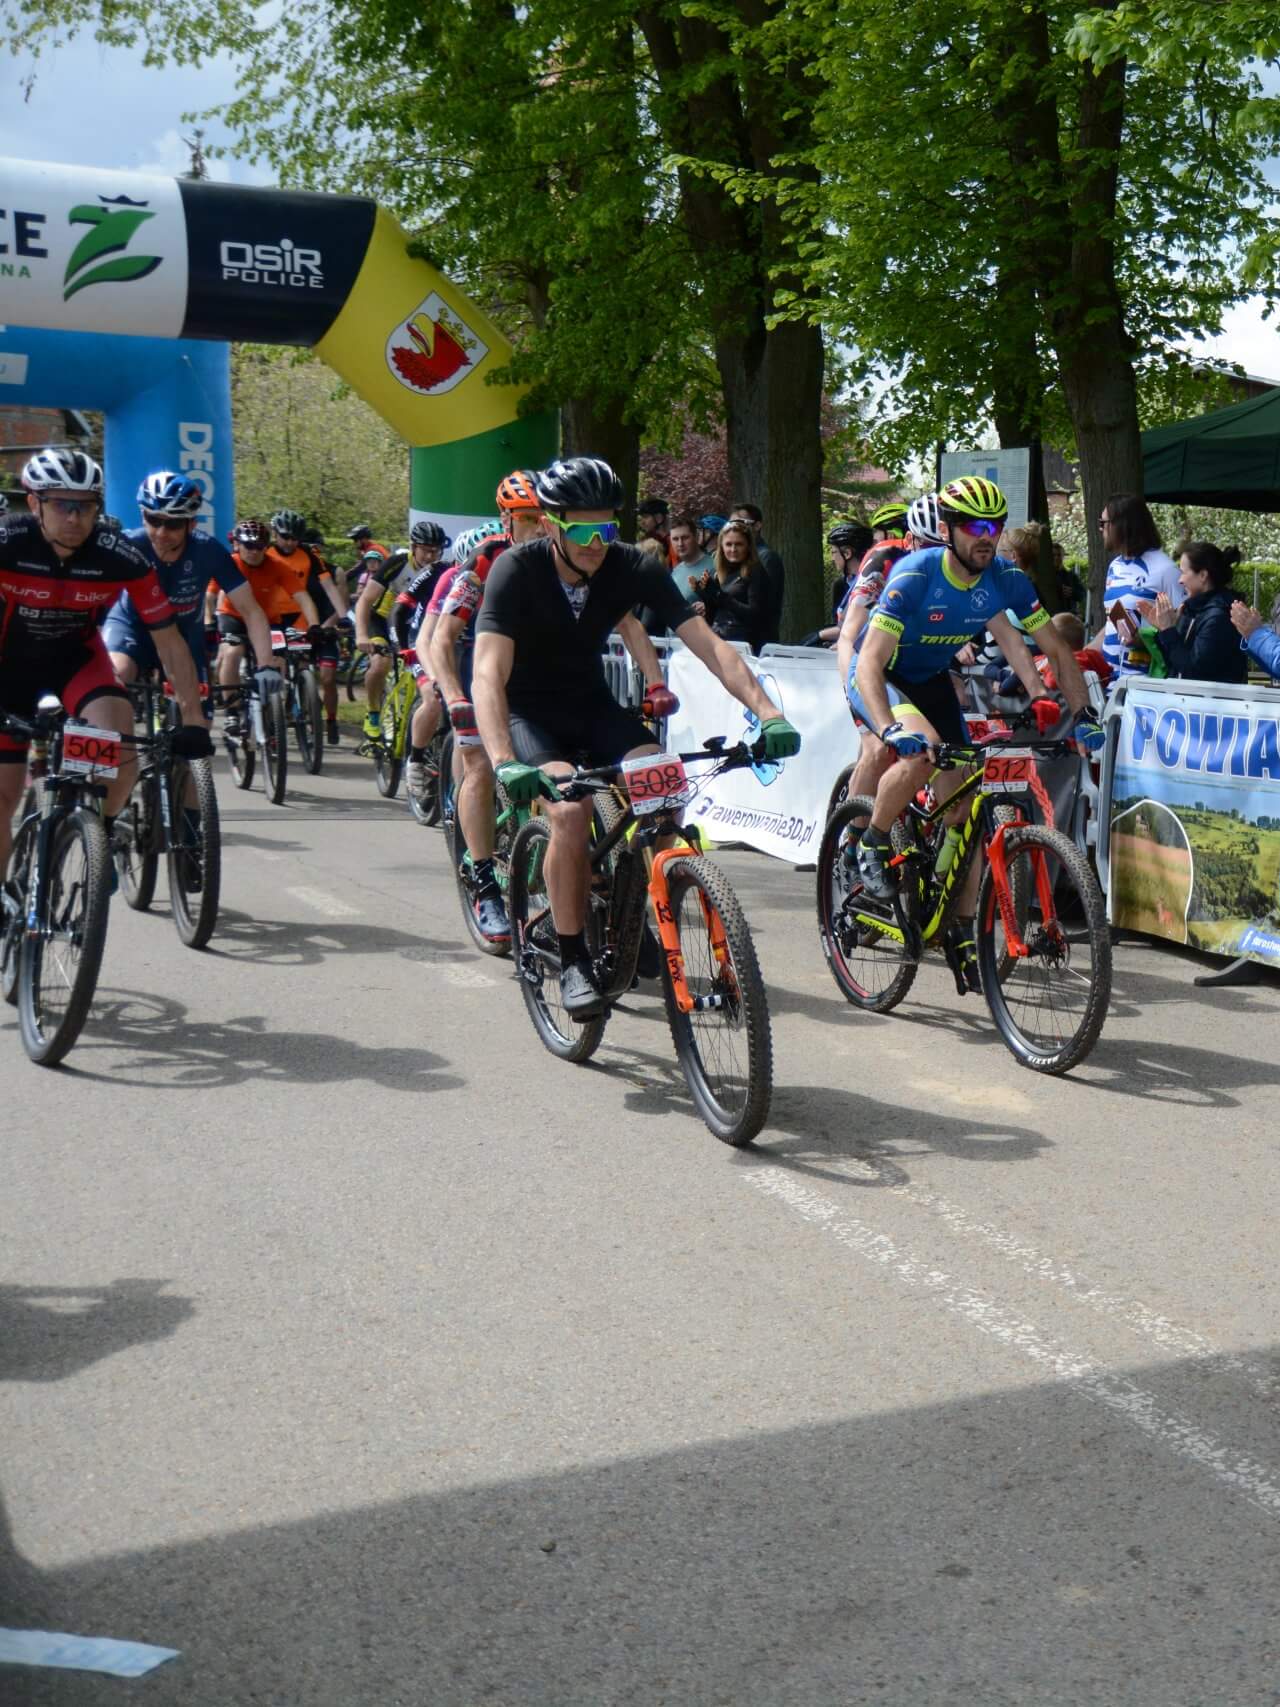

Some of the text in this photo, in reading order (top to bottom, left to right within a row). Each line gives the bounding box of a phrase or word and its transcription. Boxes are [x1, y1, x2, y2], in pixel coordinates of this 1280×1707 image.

[0, 208, 49, 259] E
[222, 267, 325, 289] POLICE
[68, 735, 117, 764] 504
[629, 765, 683, 798] 508
[985, 759, 1027, 780] 512
[1028, 1054, 1062, 1066] MAXXIS
